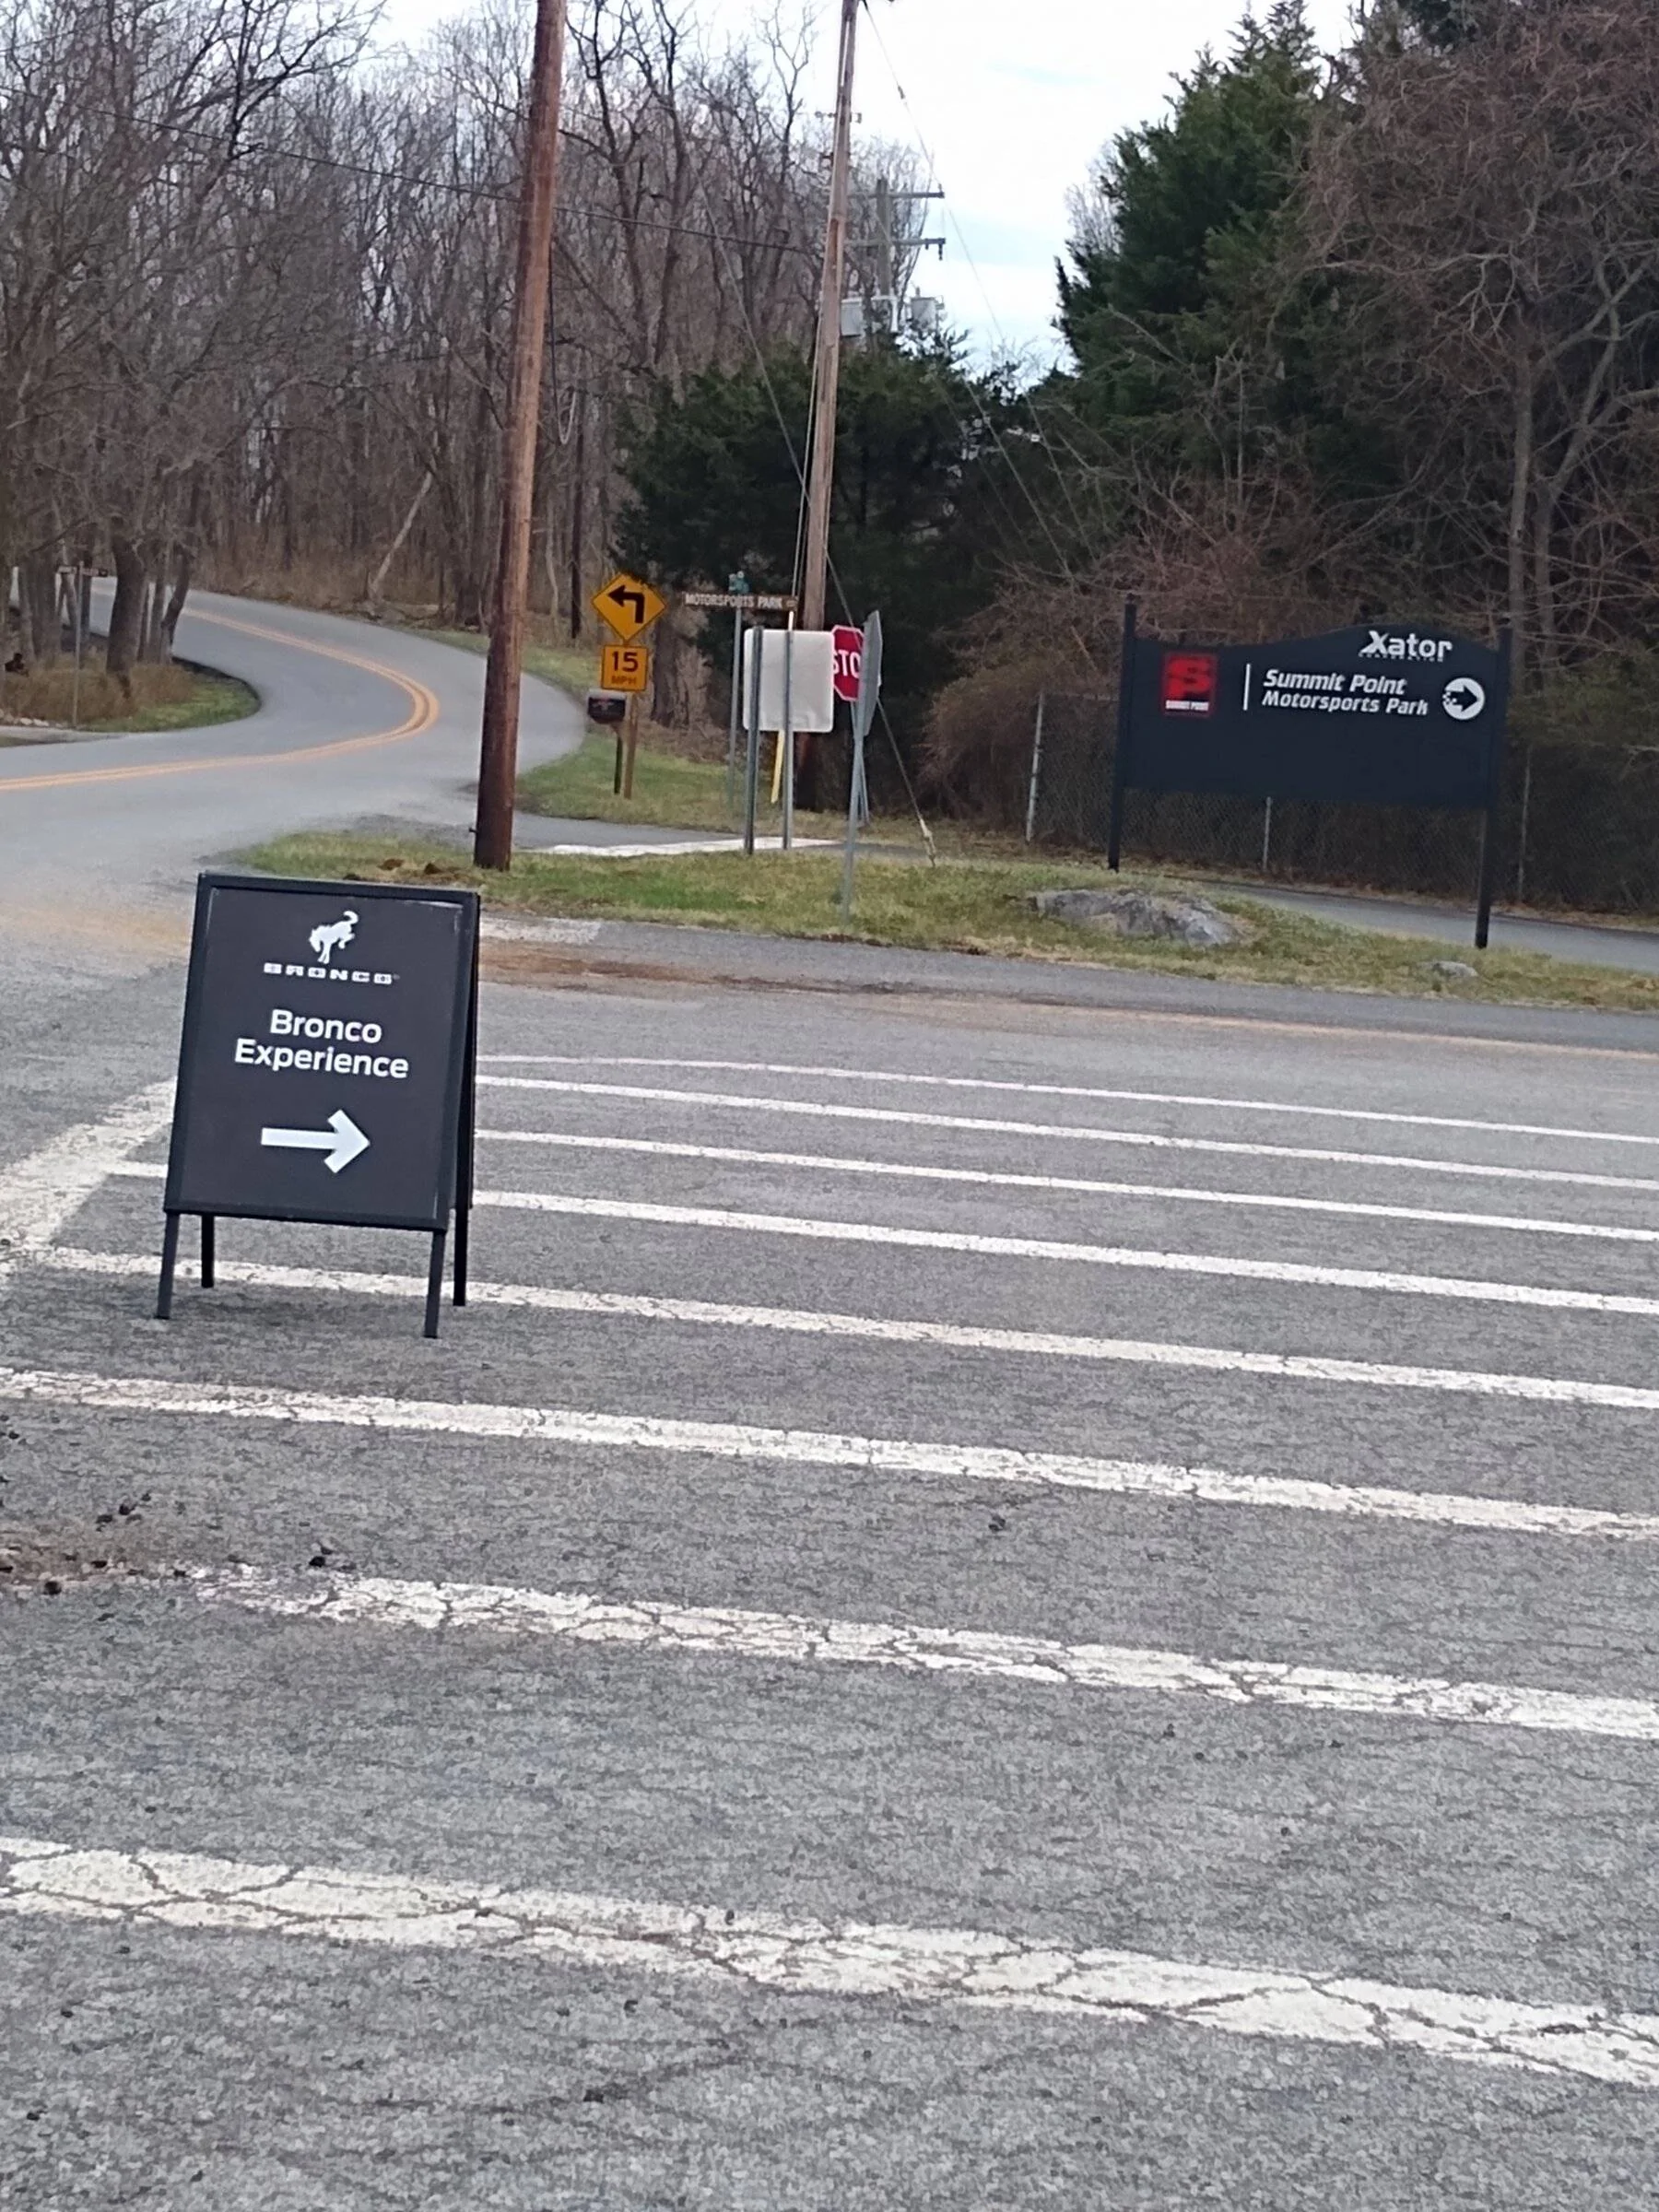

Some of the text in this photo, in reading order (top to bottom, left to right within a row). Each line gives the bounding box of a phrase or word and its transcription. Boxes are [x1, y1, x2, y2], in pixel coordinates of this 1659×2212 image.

[758, 595, 782, 609] PARK
[1359, 629, 1453, 658] Xator
[612, 651, 639, 672] 15
[833, 649, 861, 678] STO
[611, 676, 637, 685] MPH
[1263, 669, 1407, 695] Summit Point
[1262, 690, 1429, 716] Motorsports Park
[264, 962, 393, 984] BRONCO
[270, 1008, 382, 1043] Bronco
[234, 1038, 409, 1078] Experience
